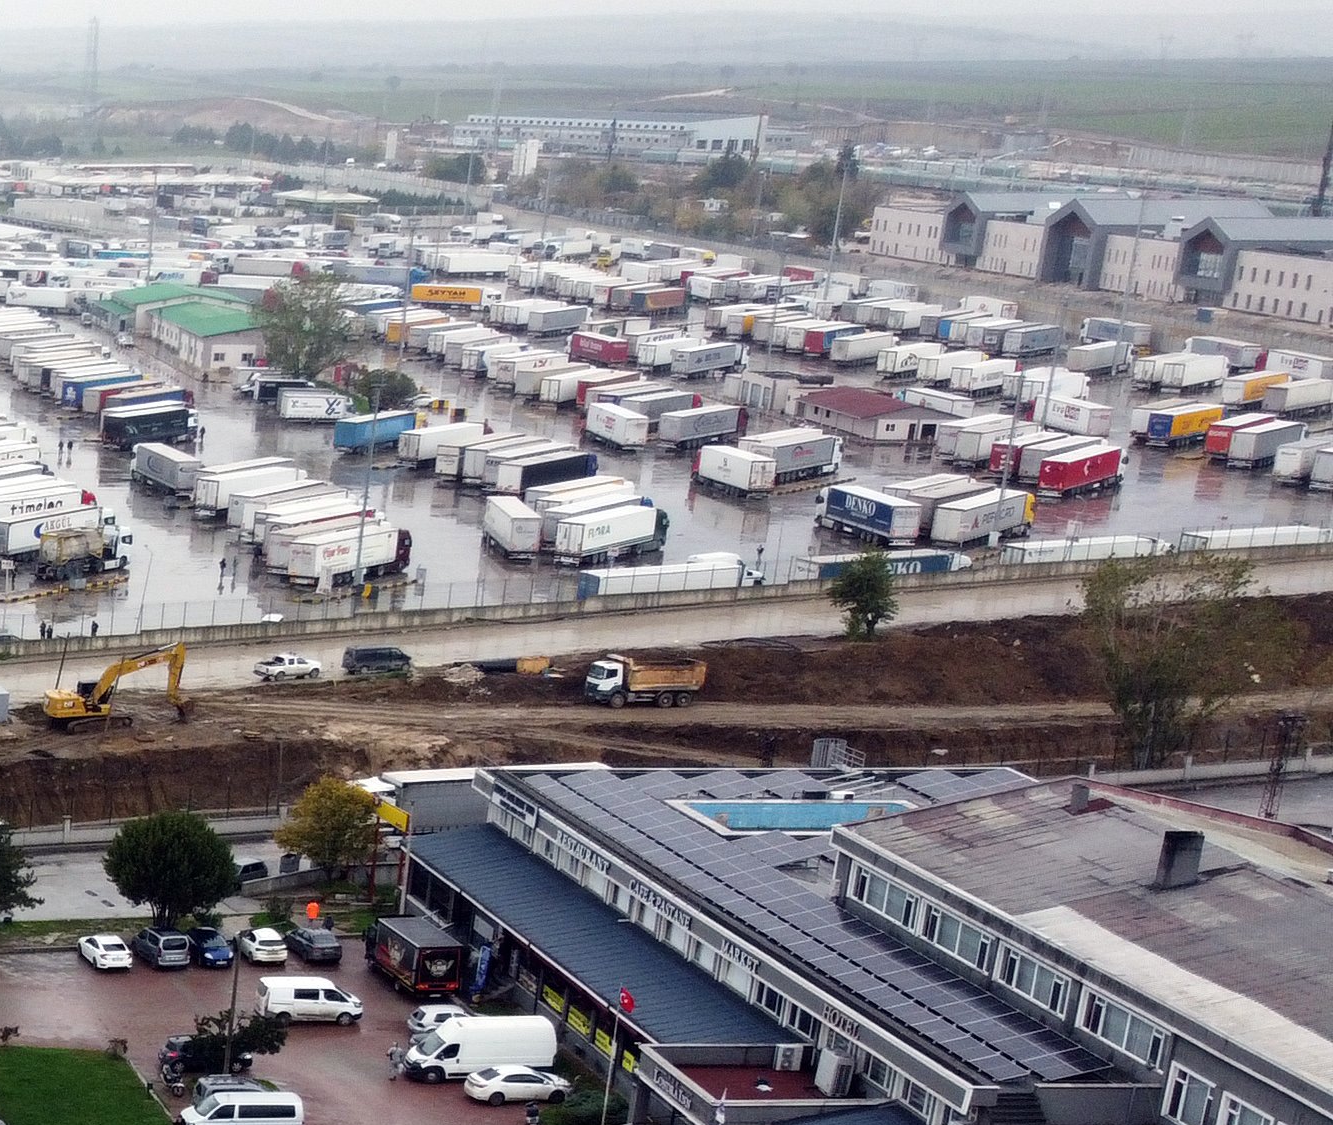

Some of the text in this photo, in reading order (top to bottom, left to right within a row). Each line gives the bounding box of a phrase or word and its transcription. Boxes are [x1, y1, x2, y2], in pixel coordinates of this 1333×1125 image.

[844, 493, 877, 517] DENKO
[555, 830, 611, 876] RESTAURANT
[721, 939, 760, 975] MARKET
[822, 1003, 860, 1042] HOTEL
